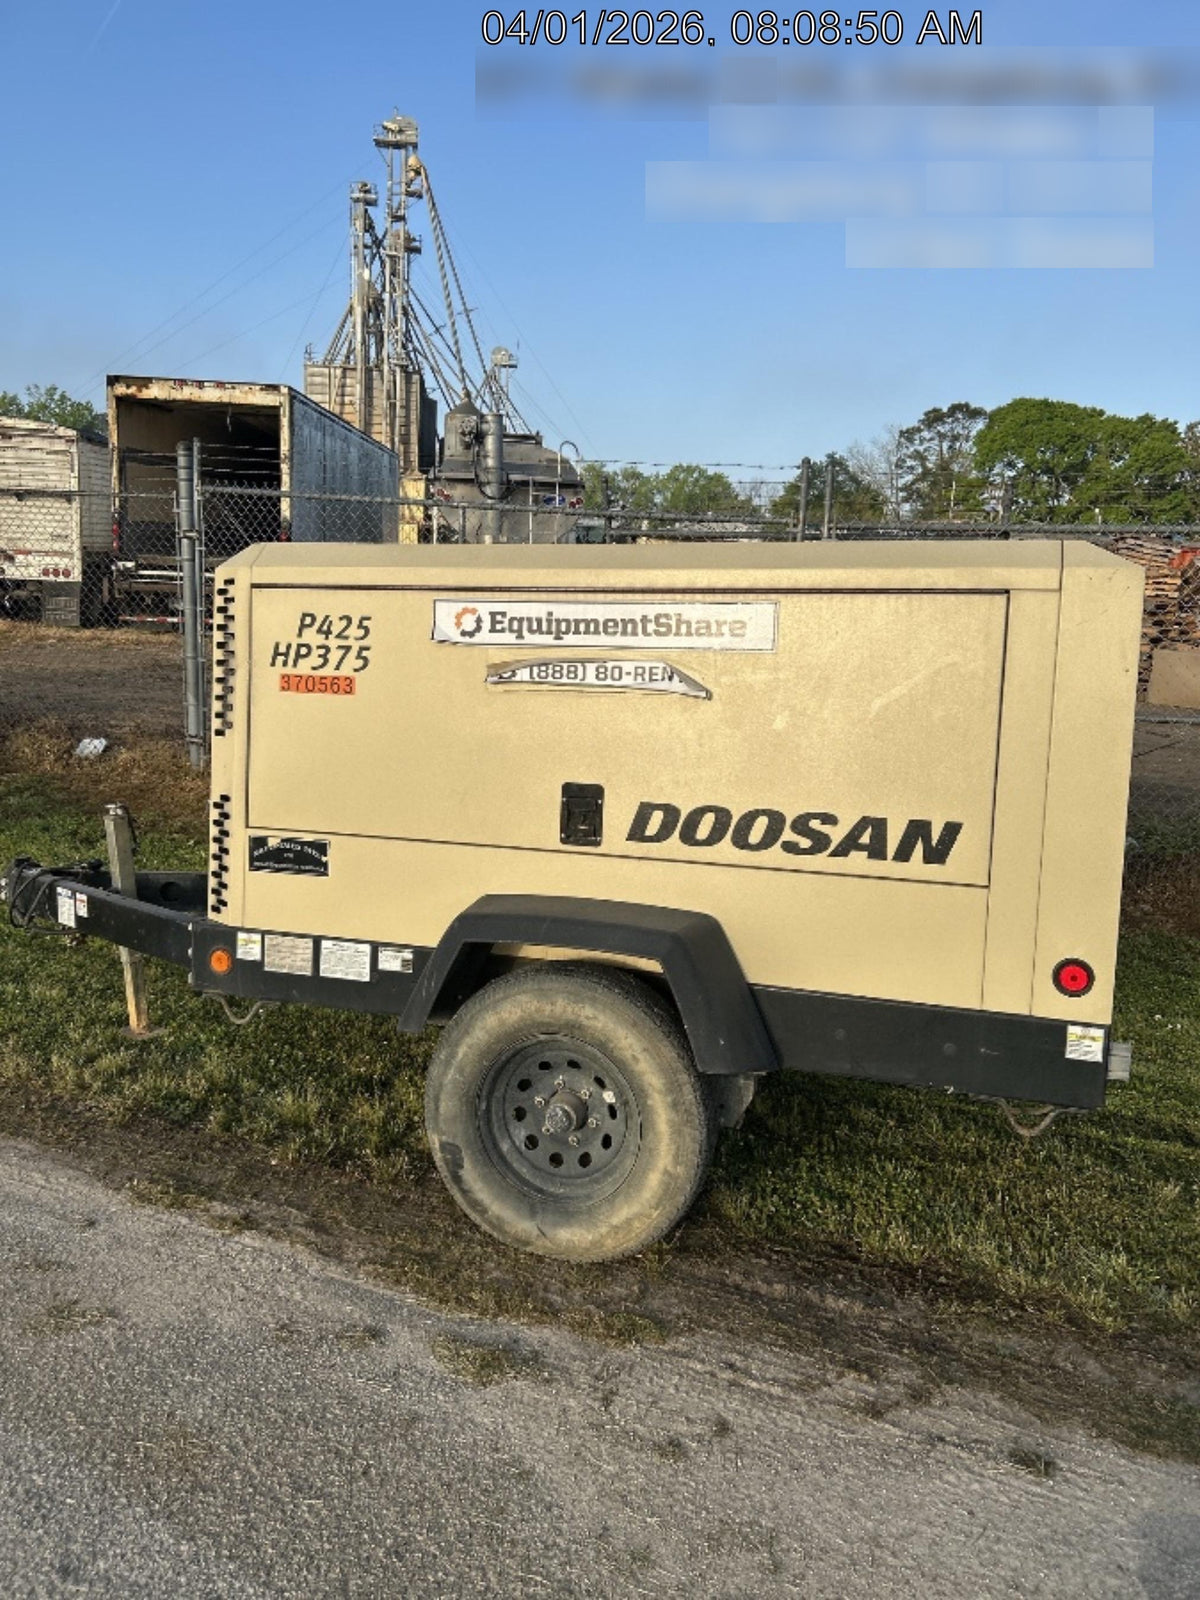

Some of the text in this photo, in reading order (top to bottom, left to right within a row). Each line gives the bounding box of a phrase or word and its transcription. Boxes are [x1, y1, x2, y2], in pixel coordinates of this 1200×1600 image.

[296, 612, 372, 641] P425
[488, 610, 748, 641] EquipmentShare
[269, 641, 372, 673] HP375
[280, 673, 354, 695] 370563
[595, 664, 684, 684] 80-REN
[626, 801, 964, 865] DOOSAN
